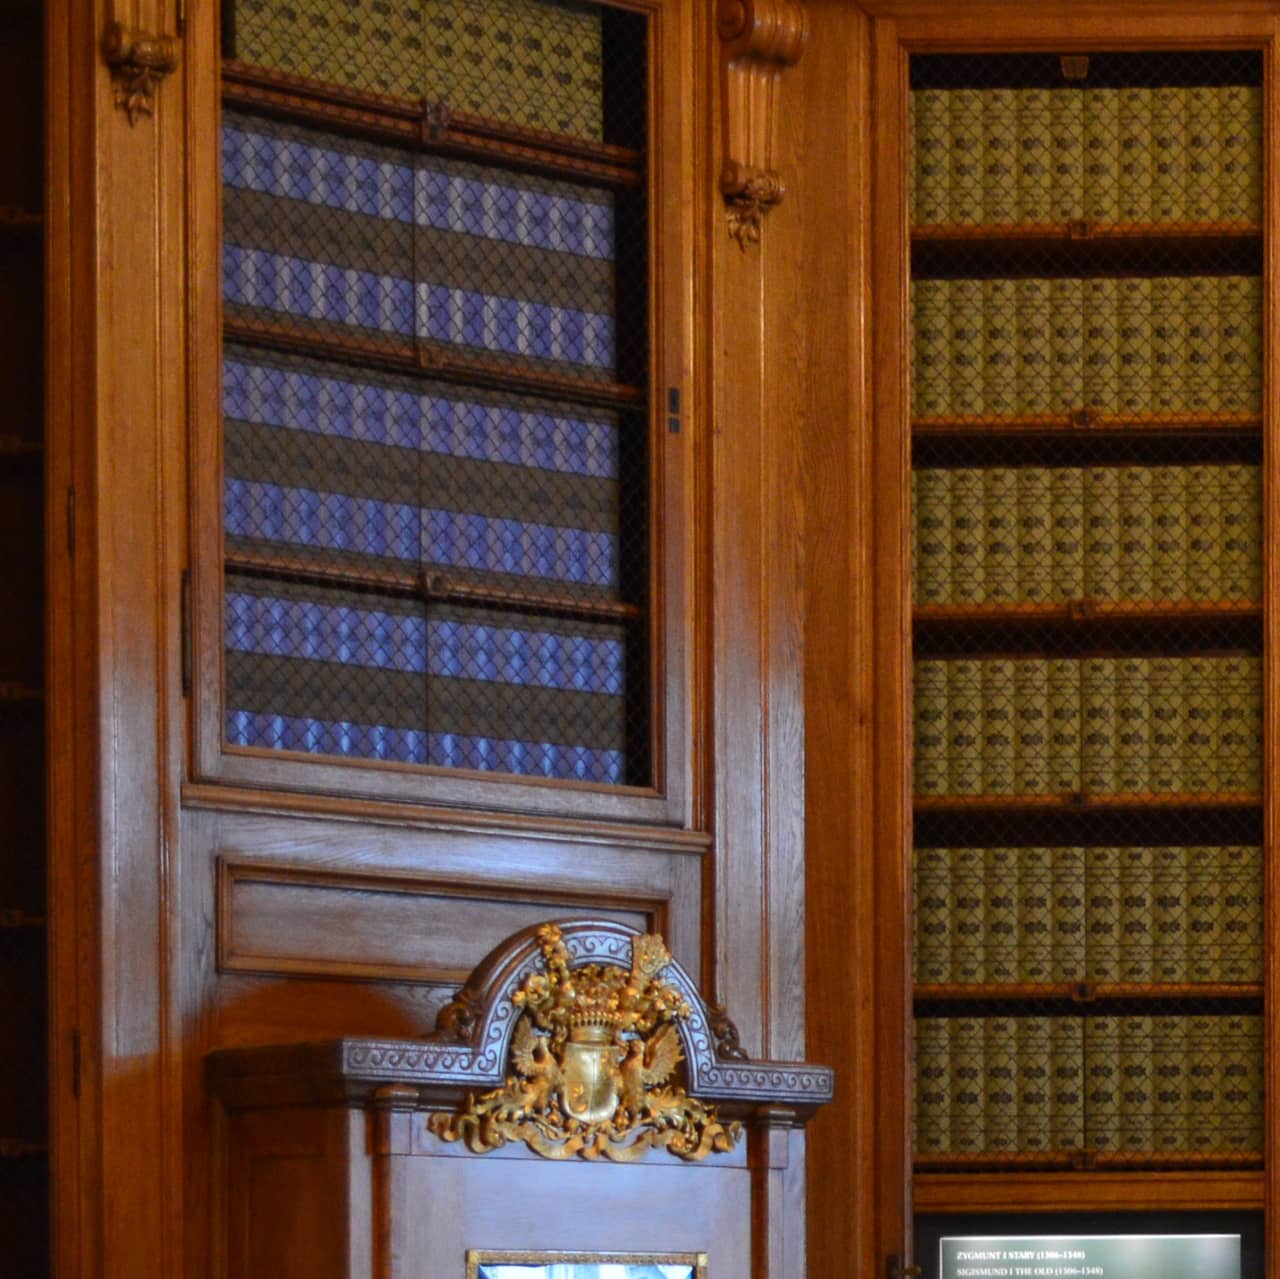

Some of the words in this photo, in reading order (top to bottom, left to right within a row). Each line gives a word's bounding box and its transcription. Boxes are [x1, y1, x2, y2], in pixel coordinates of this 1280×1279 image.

[956, 1251, 1001, 1261] ZYGMUNT
[1008, 1251, 1035, 1260] STARY
[956, 1267, 1008, 1277] SIGISMUND
[1015, 1267, 1032, 1276] THE
[1034, 1267, 1054, 1276] OLD
